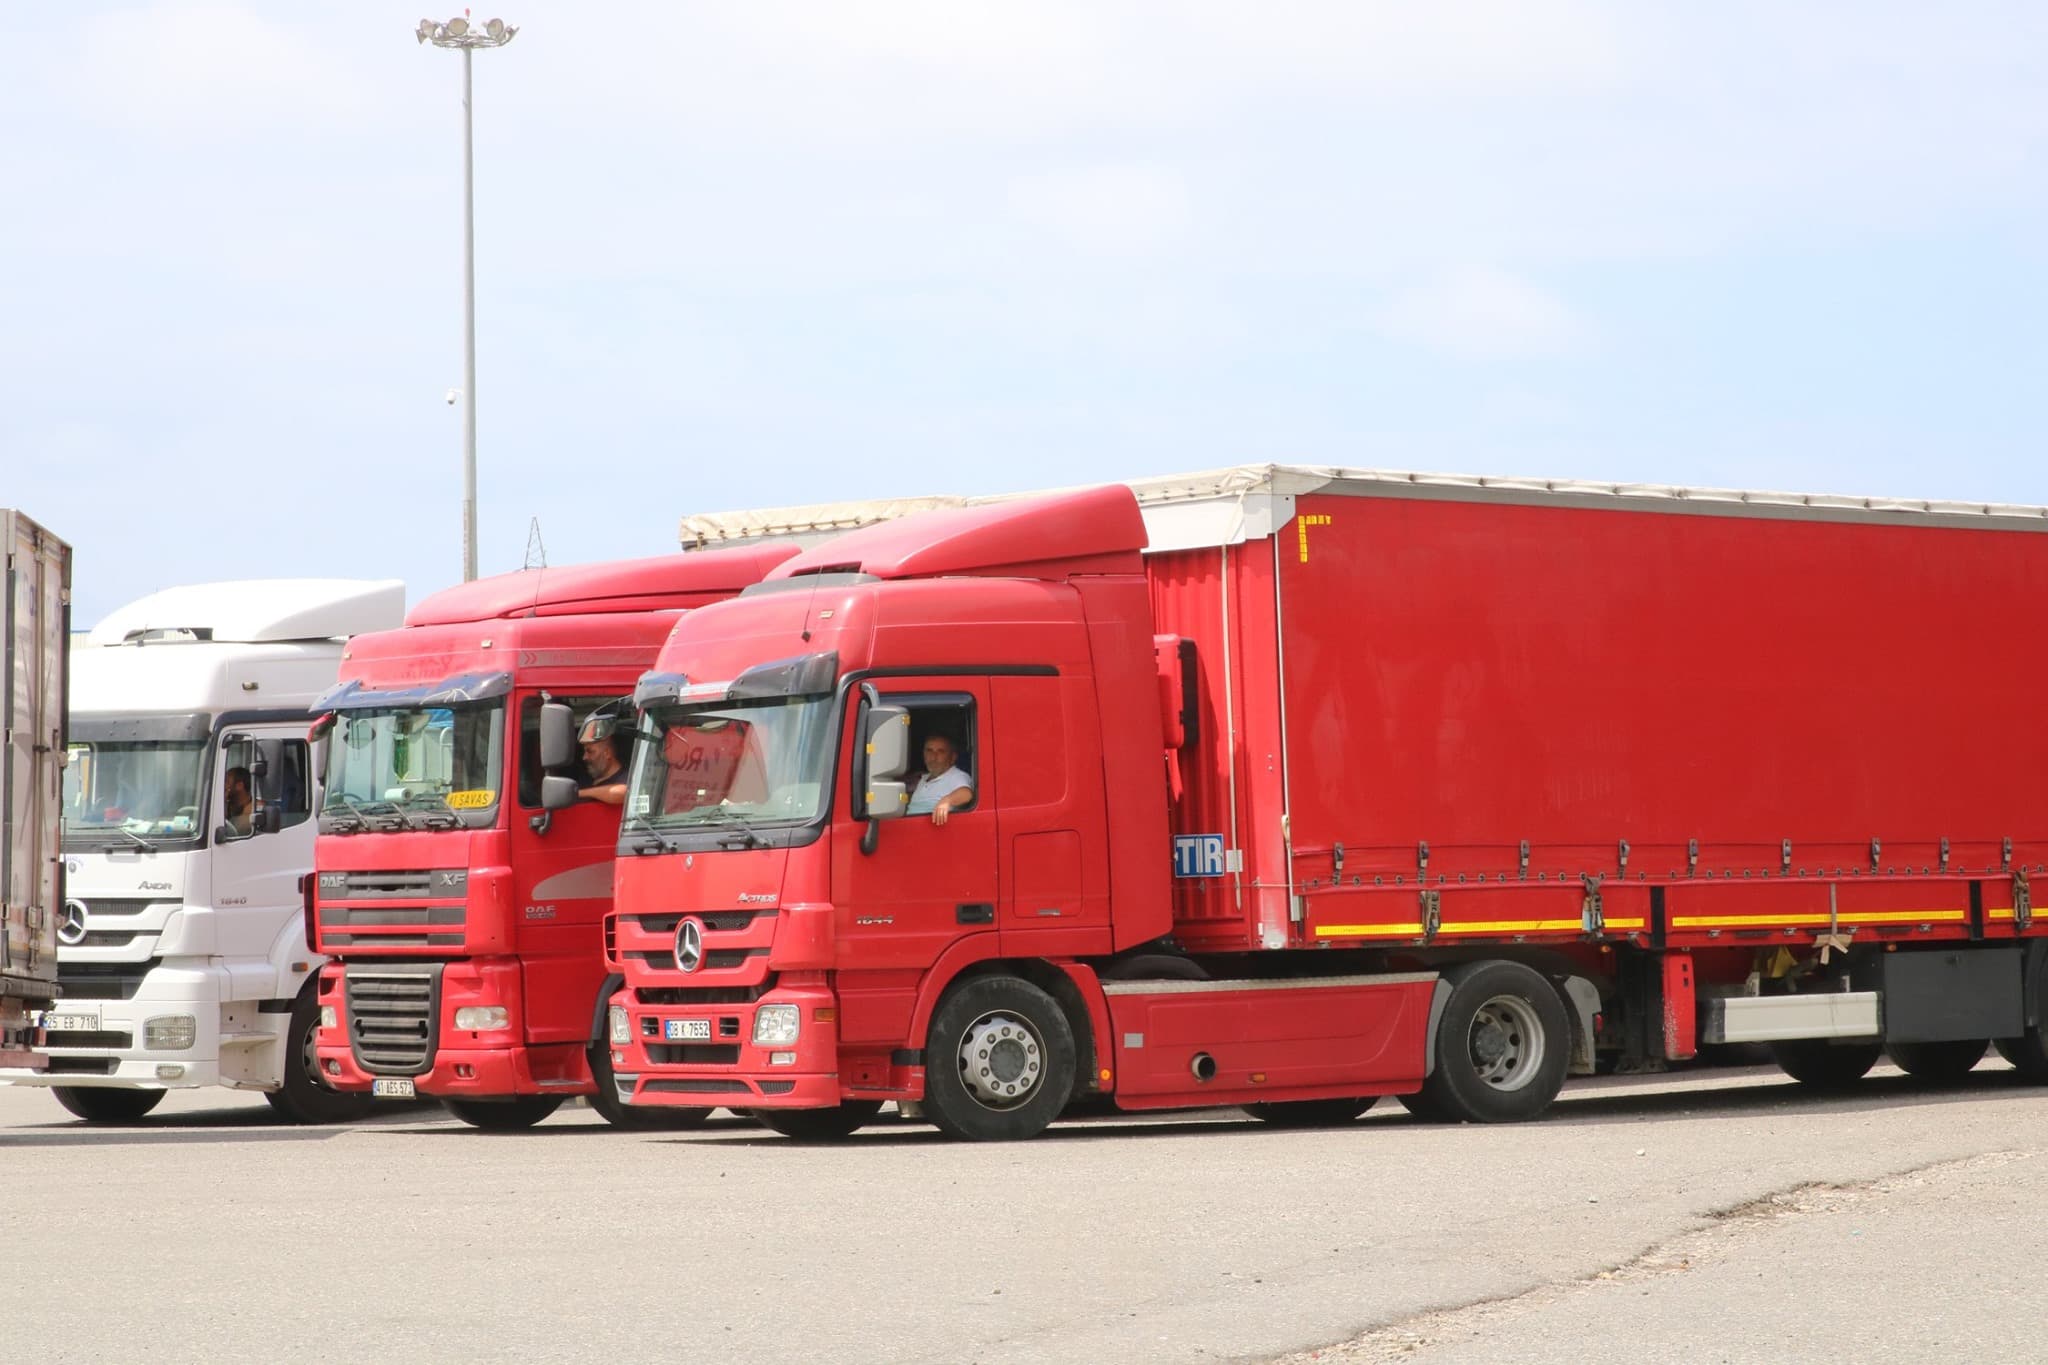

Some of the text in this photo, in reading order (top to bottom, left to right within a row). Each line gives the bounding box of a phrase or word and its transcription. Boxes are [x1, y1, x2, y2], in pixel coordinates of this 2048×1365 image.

[1176, 838, 1223, 874] TIR
[319, 875, 346, 888] DAF
[439, 872, 467, 886] XF
[525, 905, 556, 913] DAF
[47, 1016, 58, 1029] 25
[80, 1016, 97, 1029] 710
[688, 1022, 709, 1037] 7652
